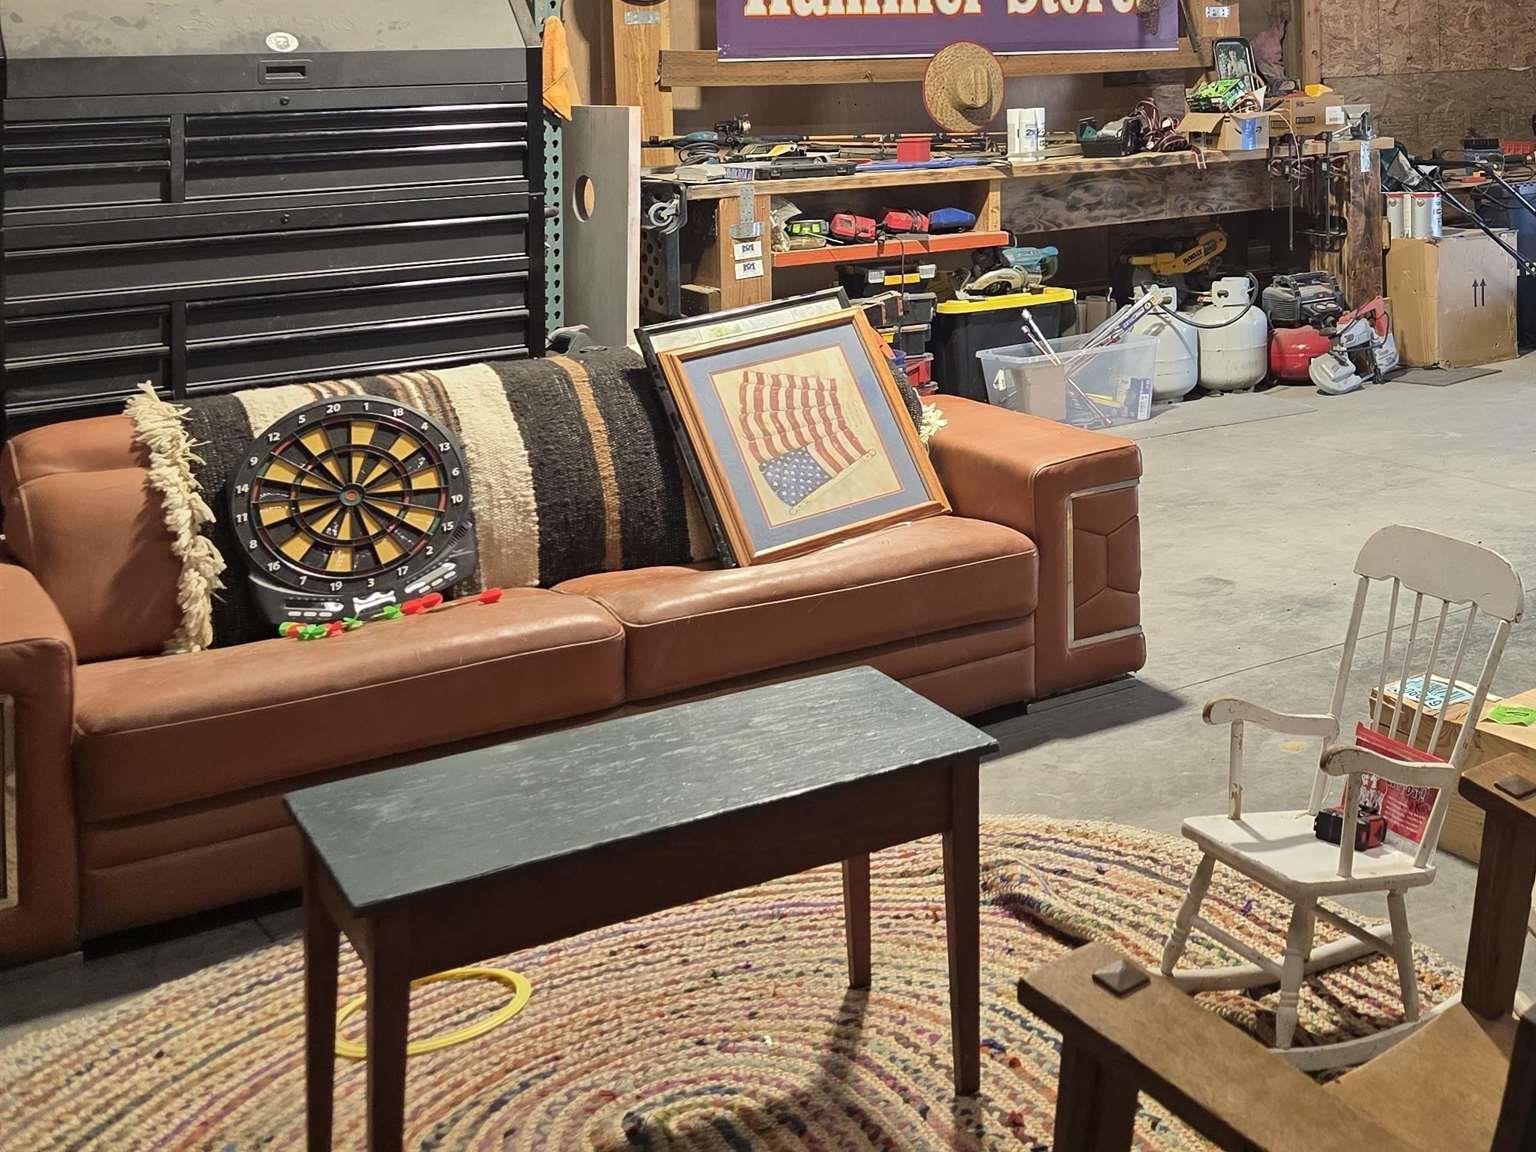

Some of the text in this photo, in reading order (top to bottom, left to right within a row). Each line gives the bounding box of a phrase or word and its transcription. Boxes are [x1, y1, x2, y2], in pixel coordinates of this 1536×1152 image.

[326, 403, 341, 414] 20
[392, 408, 404, 417] 18
[268, 432, 281, 442] 12
[439, 442, 451, 452] 13
[236, 483, 249, 494] 14
[451, 494, 464, 504] 10
[236, 512, 248, 523] 11
[441, 521, 454, 531] 15
[267, 561, 281, 571] 16
[397, 565, 409, 576] 17
[330, 581, 343, 591] 19
